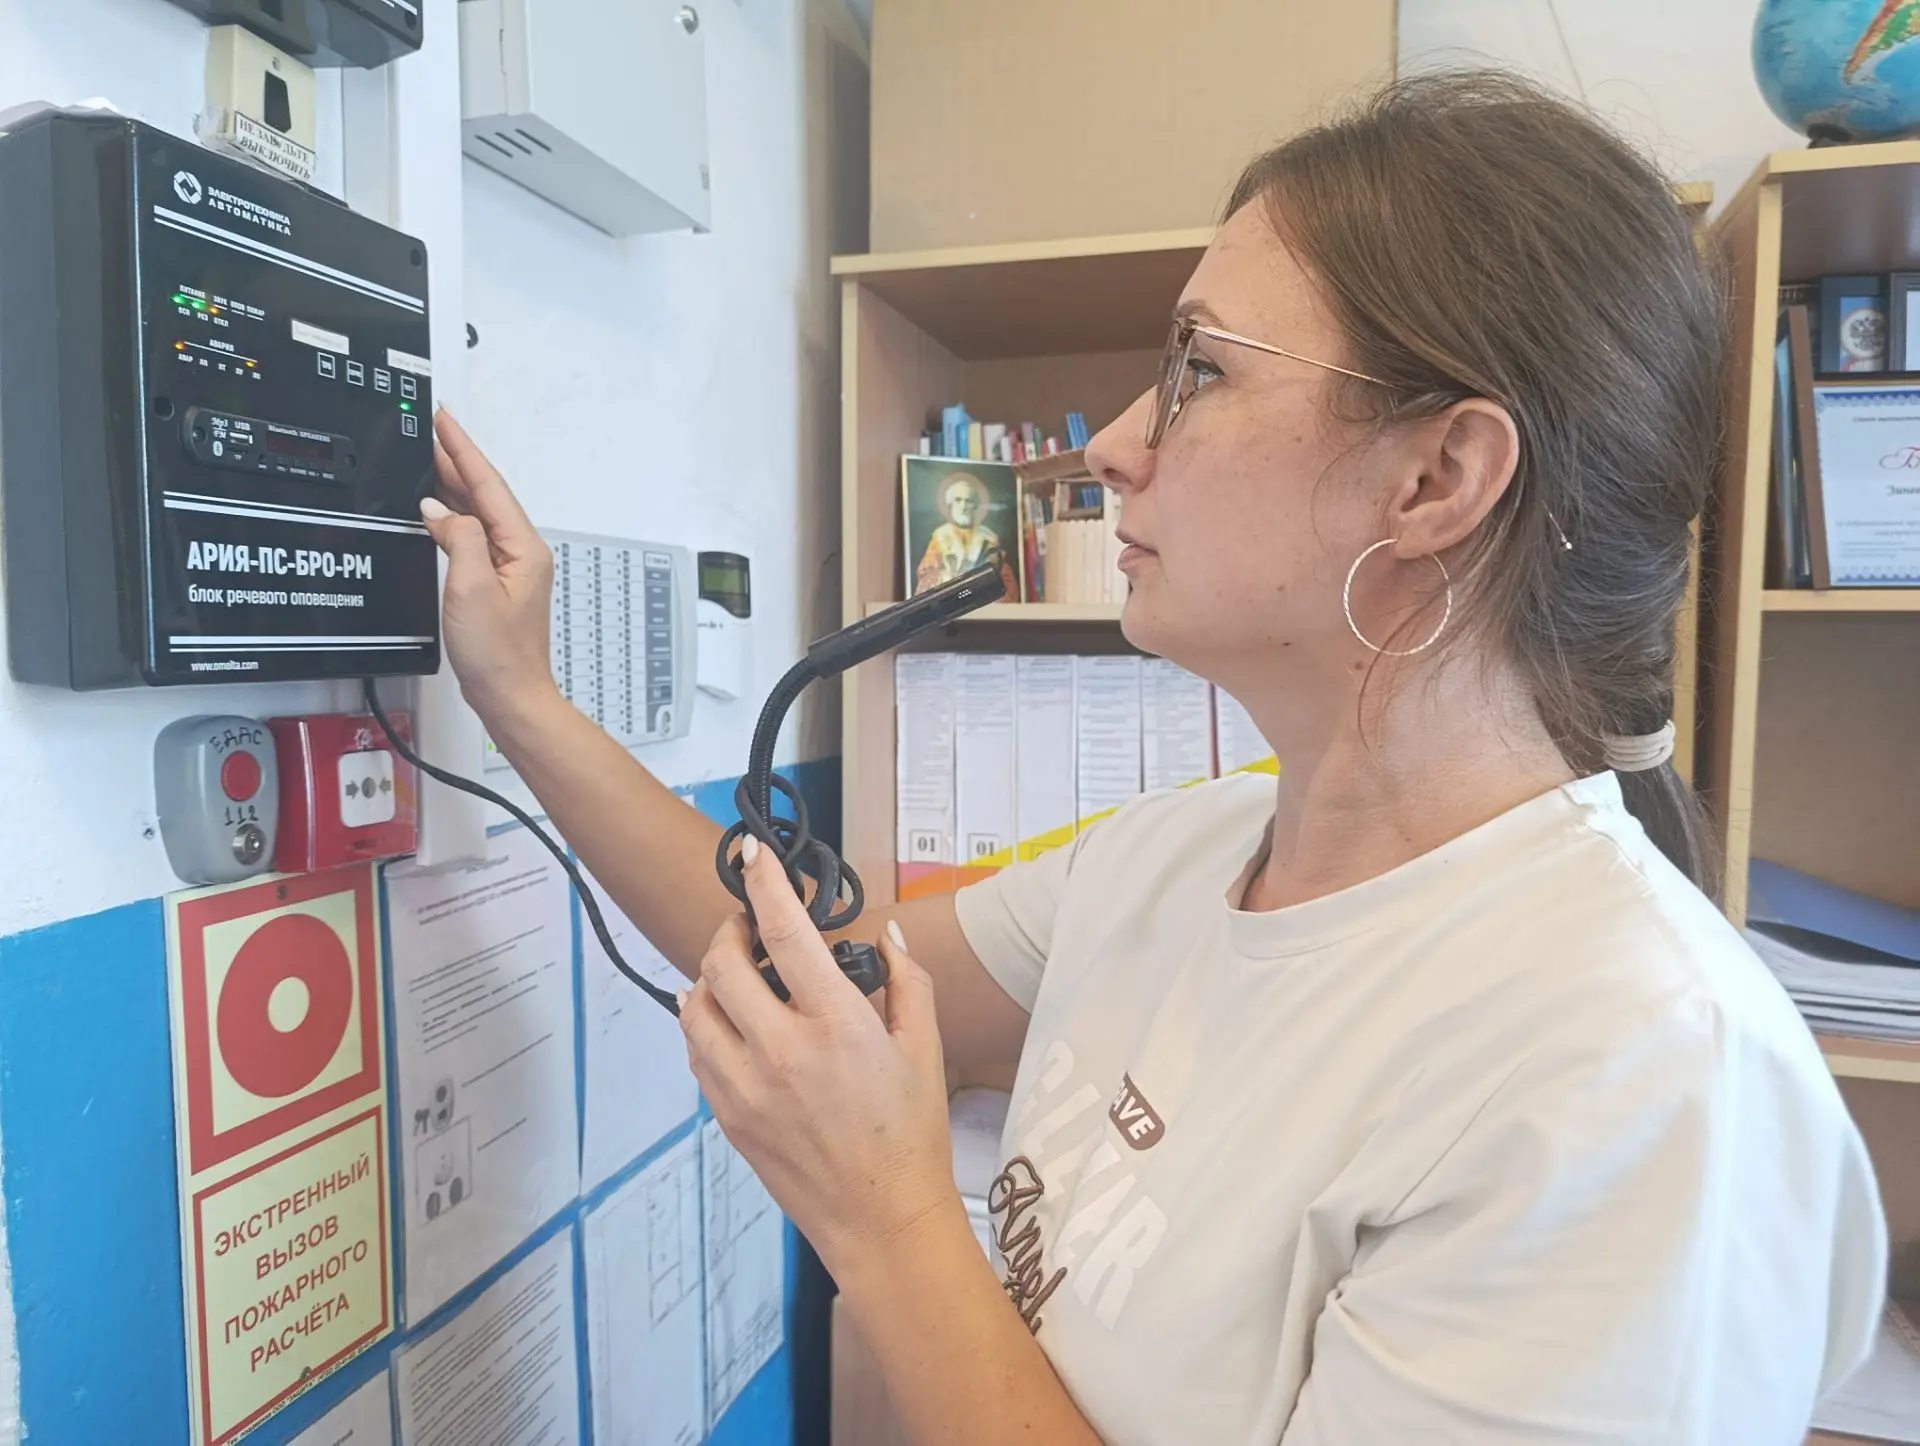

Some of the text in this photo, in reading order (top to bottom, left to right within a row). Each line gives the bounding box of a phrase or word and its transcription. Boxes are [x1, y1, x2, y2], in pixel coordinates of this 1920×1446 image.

[239, 119, 255, 135] НЕ
[239, 136, 311, 179] ВЫКЛЮЧИТЬ
[207, 186, 291, 226] ЭЛЕКТРОТЕХНИКА
[207, 198, 291, 236] АВТОМАТИКА
[234, 421, 250, 431] USB
[186, 540, 373, 580] АРИЯ-ПС-БРО-РМ
[188, 584, 365, 608] блок речевого оповещения
[223, 804, 260, 827] 112
[917, 836, 936, 853] 01
[976, 840, 994, 857] 01
[1114, 1080, 1157, 1140] AVE
[213, 1151, 371, 1258] ЭКСТРЕННЫЙ
[254, 1214, 340, 1281] ВЫЗОВ
[223, 1239, 368, 1345] ПОЖАРНОГО
[250, 1291, 350, 1374] РАСЧЁТА
